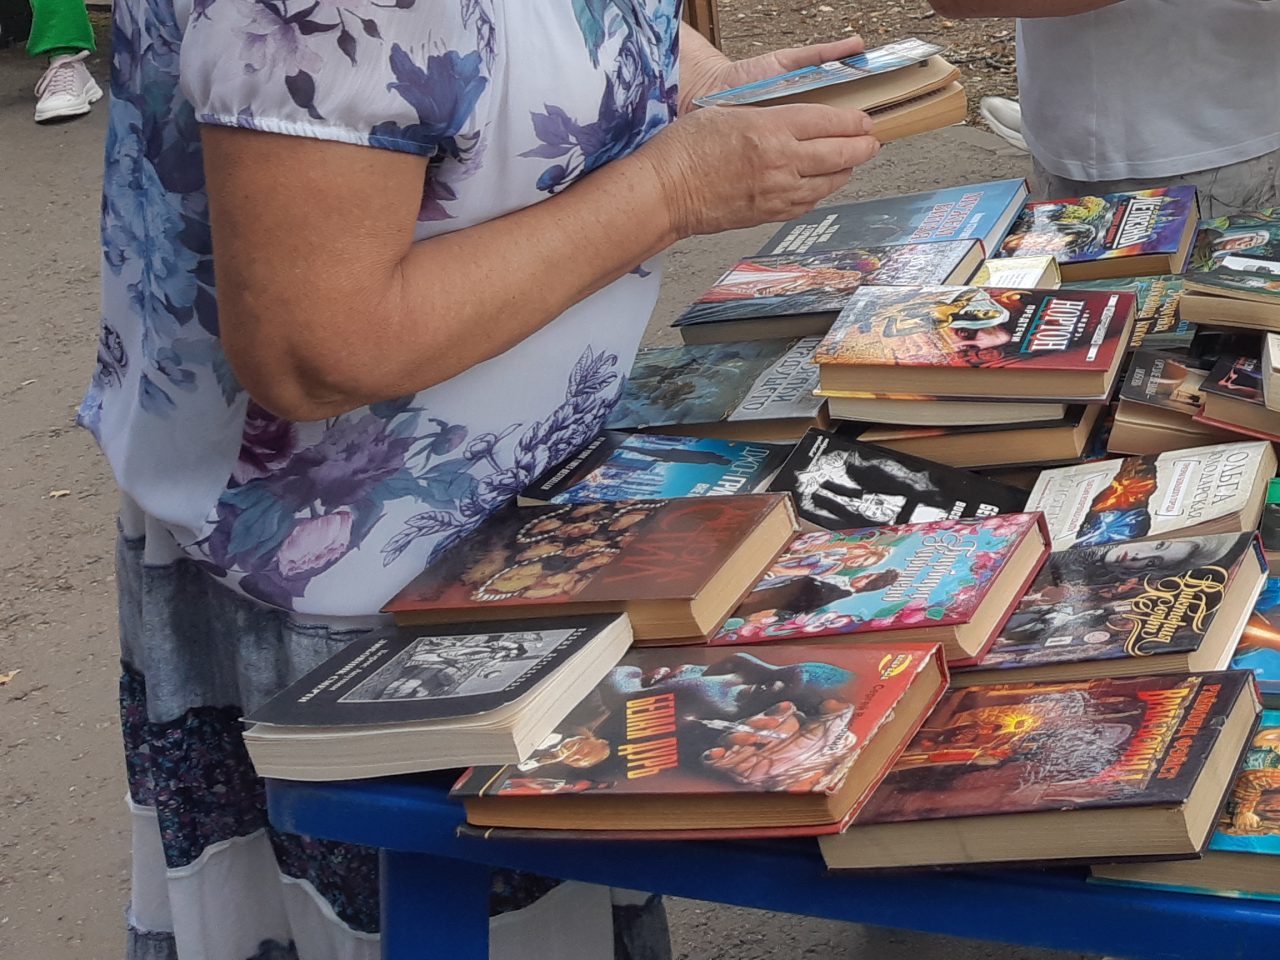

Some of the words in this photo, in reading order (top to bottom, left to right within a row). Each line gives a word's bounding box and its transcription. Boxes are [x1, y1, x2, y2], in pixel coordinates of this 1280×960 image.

[1109, 194, 1165, 248] ЖЕЛЯЗНЫ
[1007, 304, 1038, 342] ПРЕДТЕЧИ
[1025, 299, 1087, 351] НОРТОН
[770, 363, 818, 403] ЗРАКИ
[720, 447, 772, 476] ДЖОН
[1210, 450, 1250, 505] ОЛЬГА
[722, 476, 748, 497] ГРИ
[602, 503, 728, 581] СТИЛ
[333, 638, 390, 674] ЛЮБОВНИК
[295, 675, 340, 702] СМЕРТИ
[852, 684, 886, 711] Сергей
[1182, 683, 1222, 736] РАЙМОНД
[626, 692, 674, 740] БЕЛАЯ
[618, 736, 675, 780] ДУРЬ
[1154, 737, 1196, 779] ФЭЙСТ
